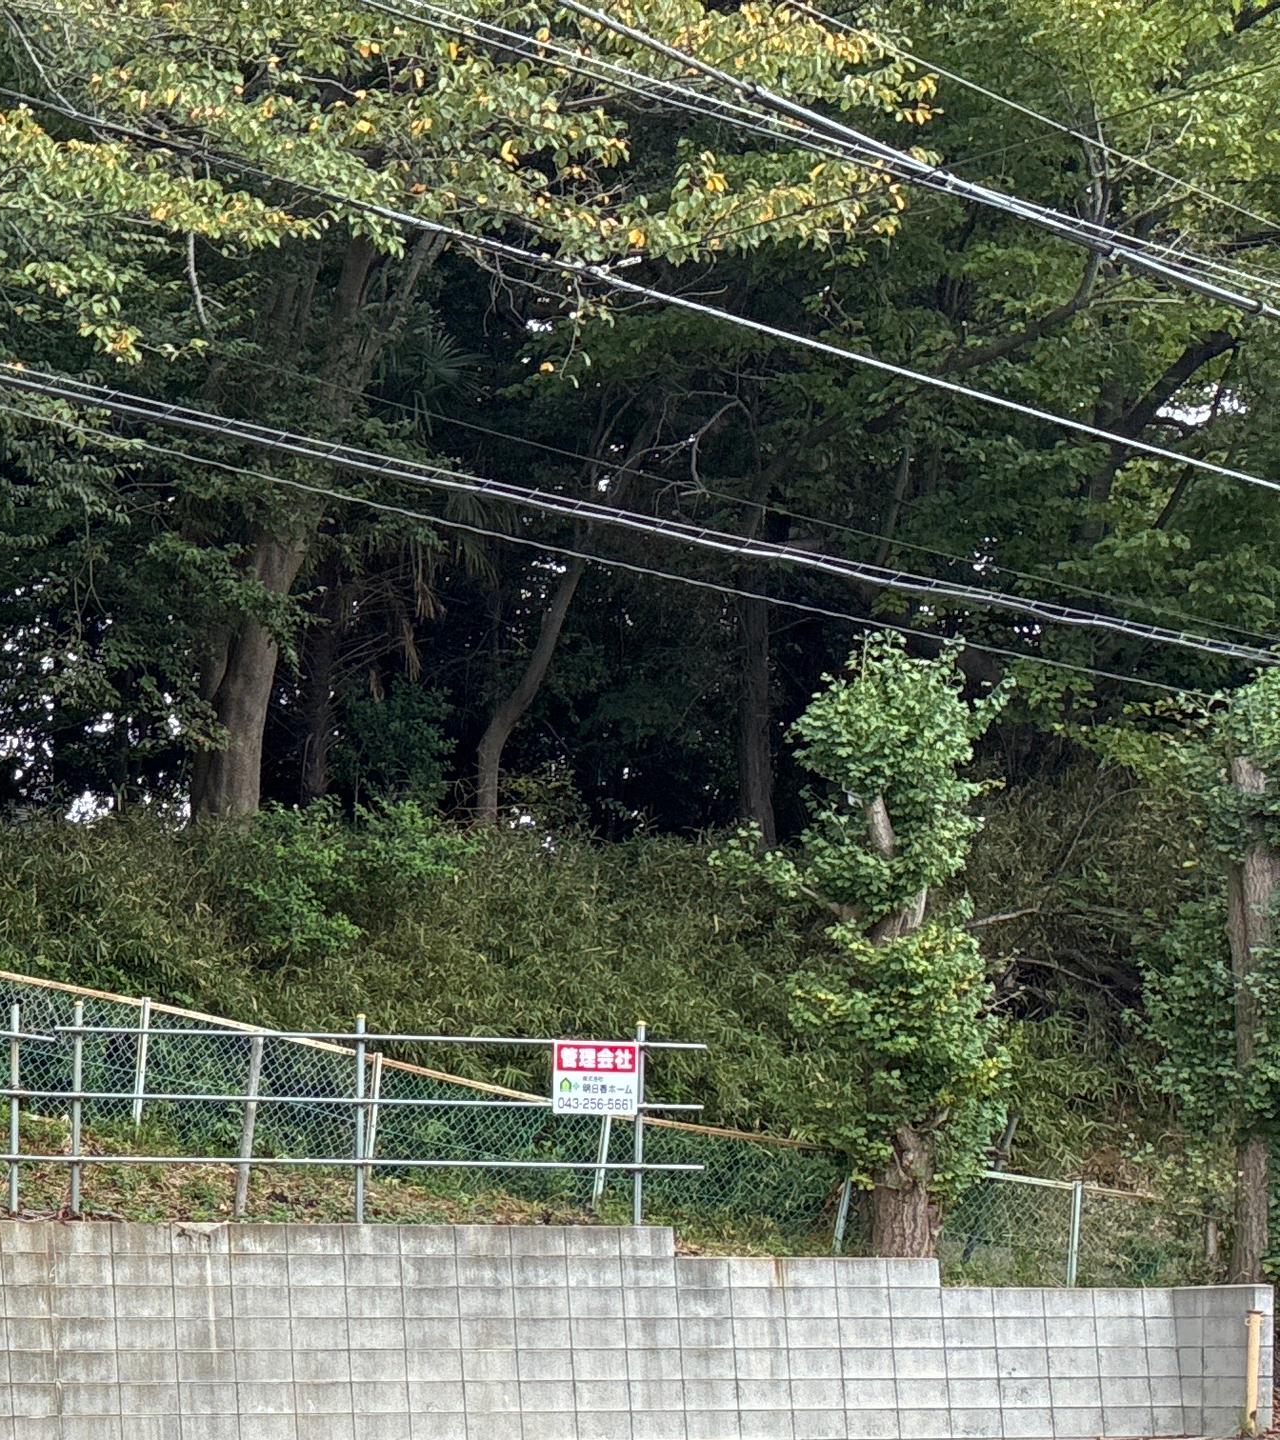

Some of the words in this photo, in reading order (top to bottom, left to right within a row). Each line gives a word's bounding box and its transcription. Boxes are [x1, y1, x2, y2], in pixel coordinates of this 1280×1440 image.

[560, 1047, 633, 1069] 管理会社
[557, 1097, 633, 1110] 043-256-5661
